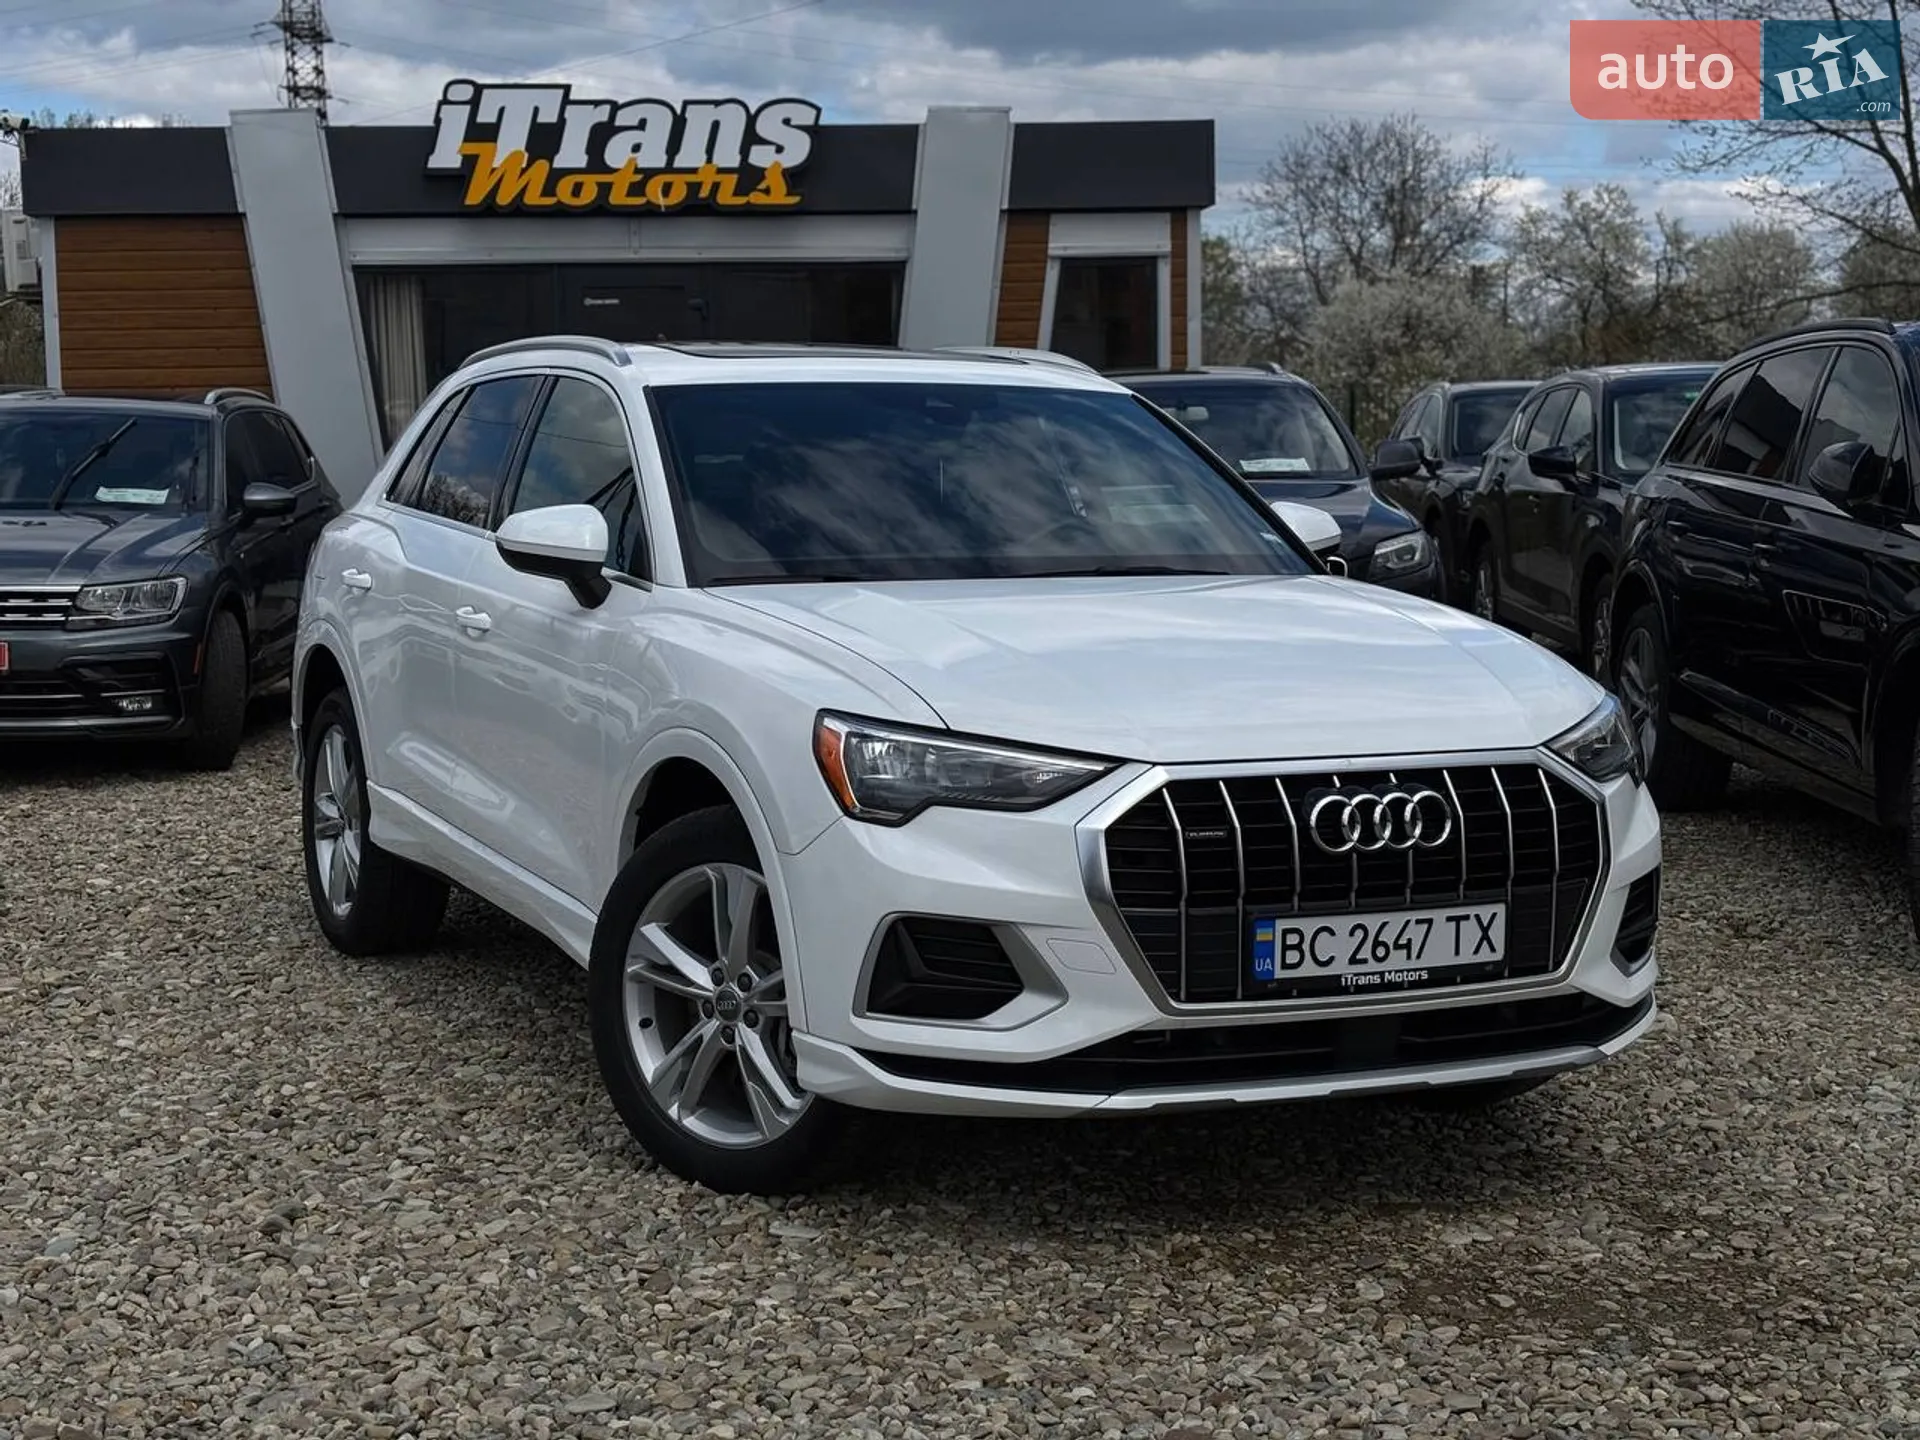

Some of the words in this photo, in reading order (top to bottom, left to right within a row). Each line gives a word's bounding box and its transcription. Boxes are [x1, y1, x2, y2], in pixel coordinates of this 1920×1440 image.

[427, 83, 817, 169] iTrans
[458, 142, 801, 206] Motors
[1255, 957, 1273, 972] UA
[1280, 925, 1337, 970] BC
[1348, 917, 1434, 965] 2647
[1446, 912, 1498, 957] TX
[1341, 974, 1381, 986] iTrans
[1385, 969, 1429, 983] Motors
